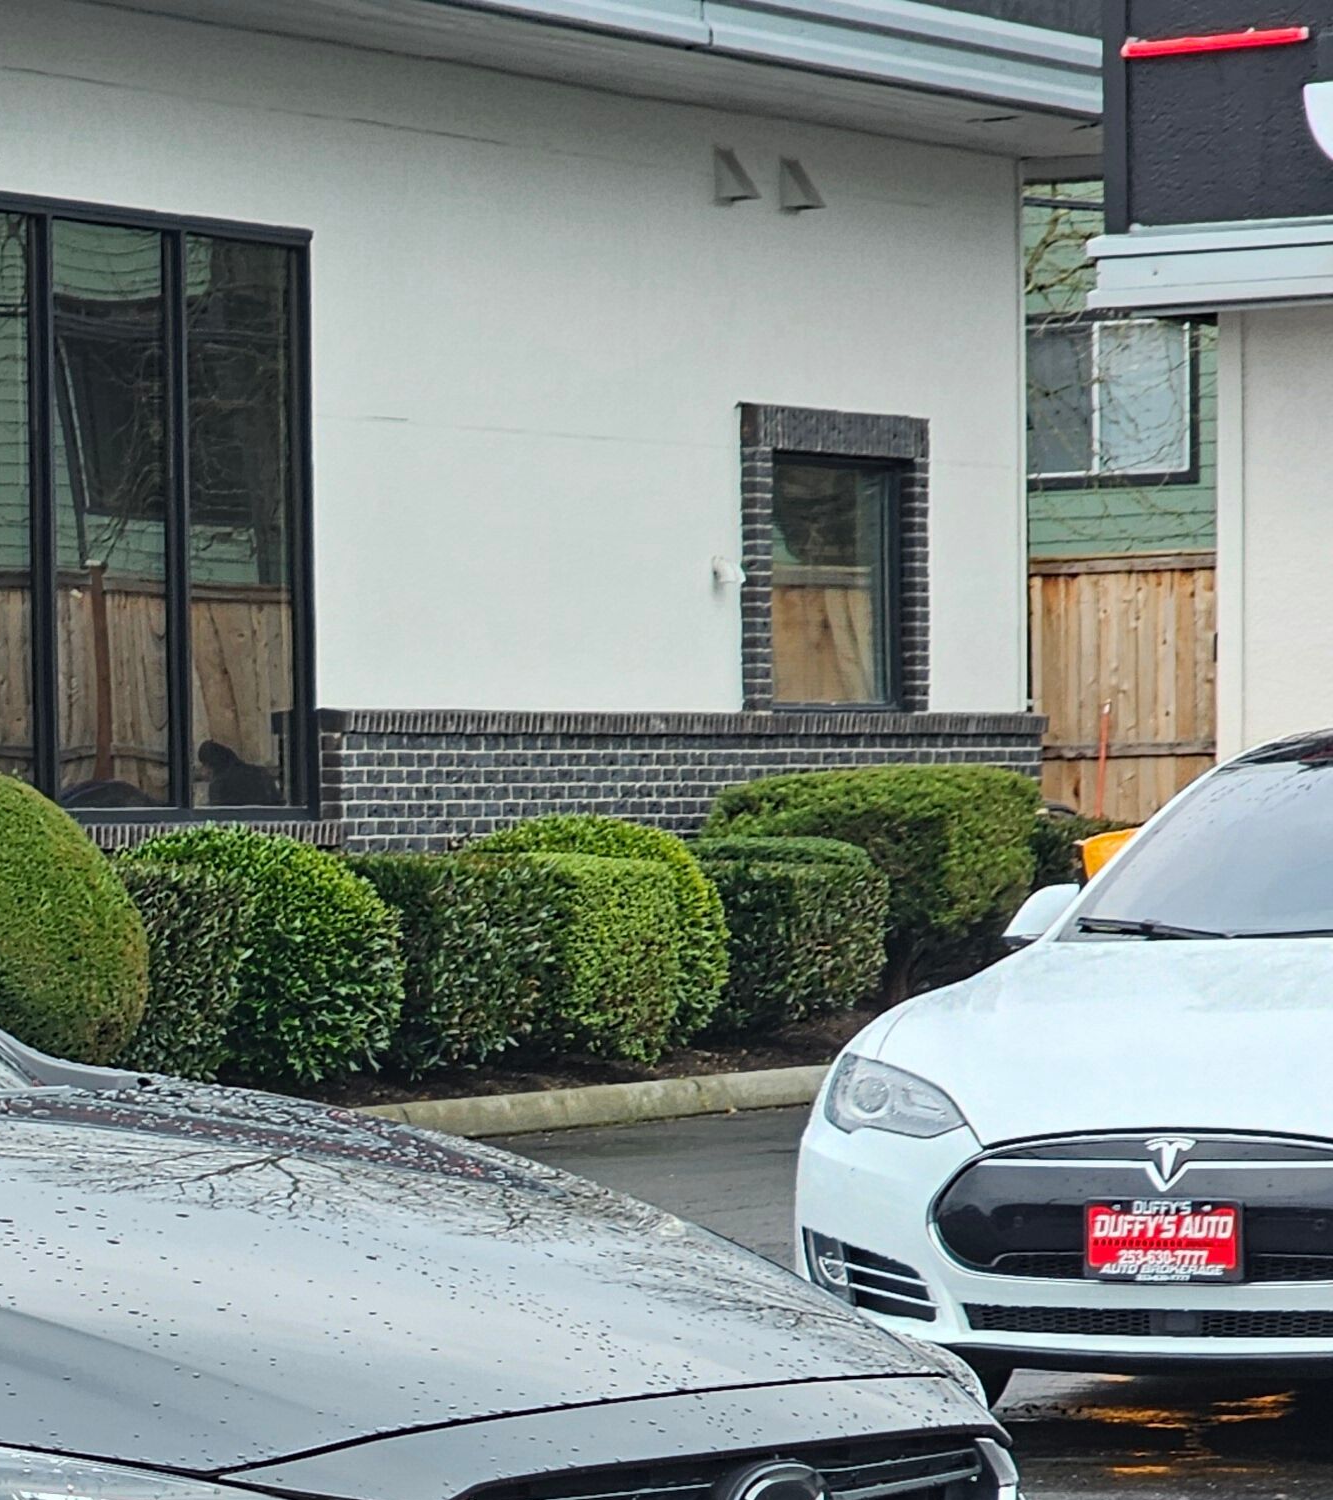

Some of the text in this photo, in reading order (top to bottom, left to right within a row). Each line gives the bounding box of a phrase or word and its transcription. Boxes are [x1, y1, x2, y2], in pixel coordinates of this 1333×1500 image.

[1131, 1200, 1192, 1215] DUFFY'S
[1093, 1215, 1234, 1238] DUFFY'S AUTO
[1099, 1263, 1138, 1275] AUTO
